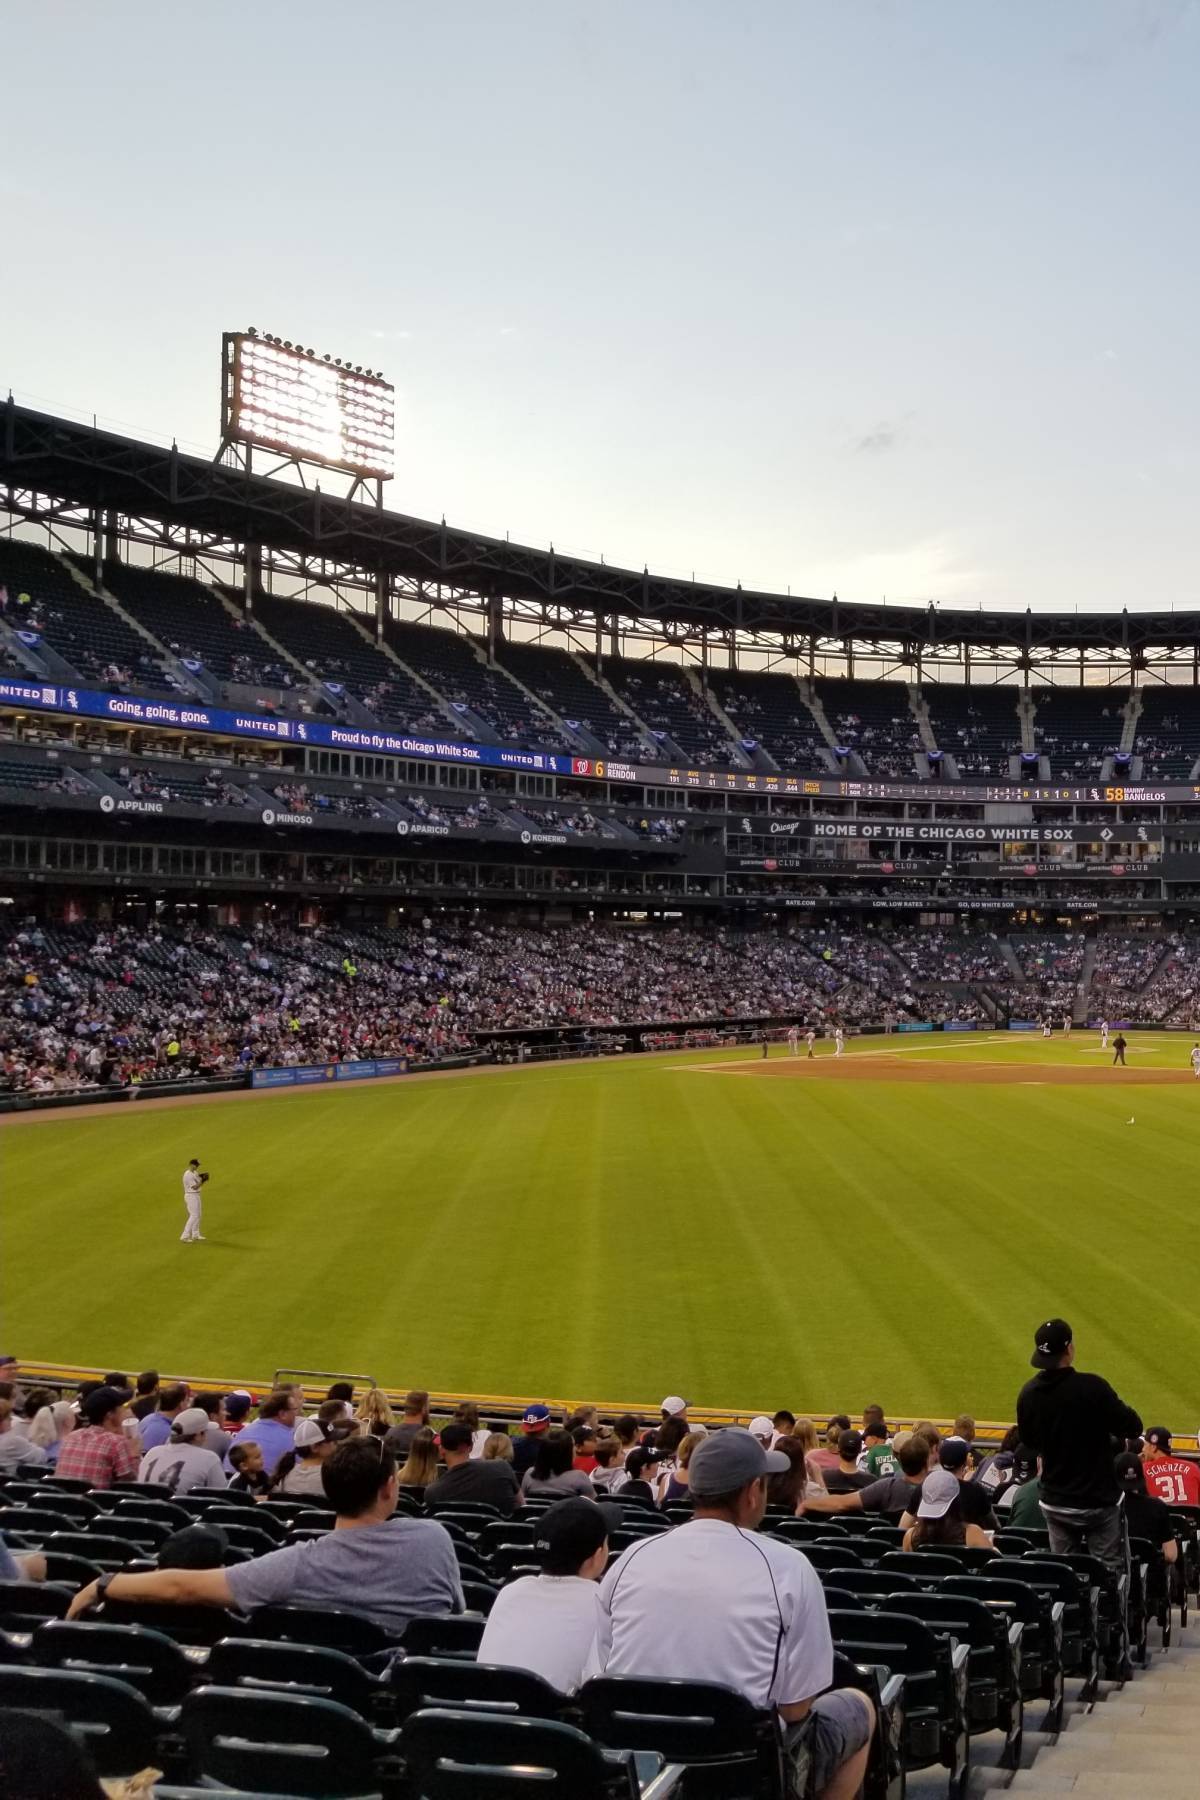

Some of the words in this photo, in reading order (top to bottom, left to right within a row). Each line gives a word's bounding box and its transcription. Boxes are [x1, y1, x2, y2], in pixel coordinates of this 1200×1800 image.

[0, 685, 41, 700] NITED
[109, 699, 144, 717] Going,
[146, 706, 179, 721] going,
[181, 709, 210, 724] gone.
[236, 718, 277, 732] UNITED
[331, 730, 360, 744] Proud
[361, 734, 371, 745] to
[372, 735, 385, 749] fly
[386, 737, 401, 749] the
[402, 739, 435, 754] Chicago
[435, 743, 462, 757] White
[462, 747, 481, 760] Sox.
[501, 753, 533, 765] UNITED
[595, 761, 604, 777] 6
[607, 768, 636, 780] RENDON
[1035, 790, 1040, 799] 1
[1055, 790, 1060, 799] 1
[1075, 790, 1080, 799] 1
[1106, 788, 1124, 800] 58
[117, 800, 163, 812] APPLING
[276, 814, 313, 824] MINOSO
[410, 824, 449, 834] APARICIO
[770, 822, 800, 834] Chicago
[815, 824, 857, 836] HOME
[862, 825, 881, 836] OF
[886, 826, 914, 837] THE
[919, 827, 986, 839] CHICAGO
[991, 828, 1039, 840] WHITE
[1044, 829, 1073, 840] SOX
[778, 859, 800, 867] CLUB
[144, 1458, 186, 1492] 14
[1146, 1463, 1191, 1478] SCHERZER
[1156, 1474, 1188, 1503] 31
